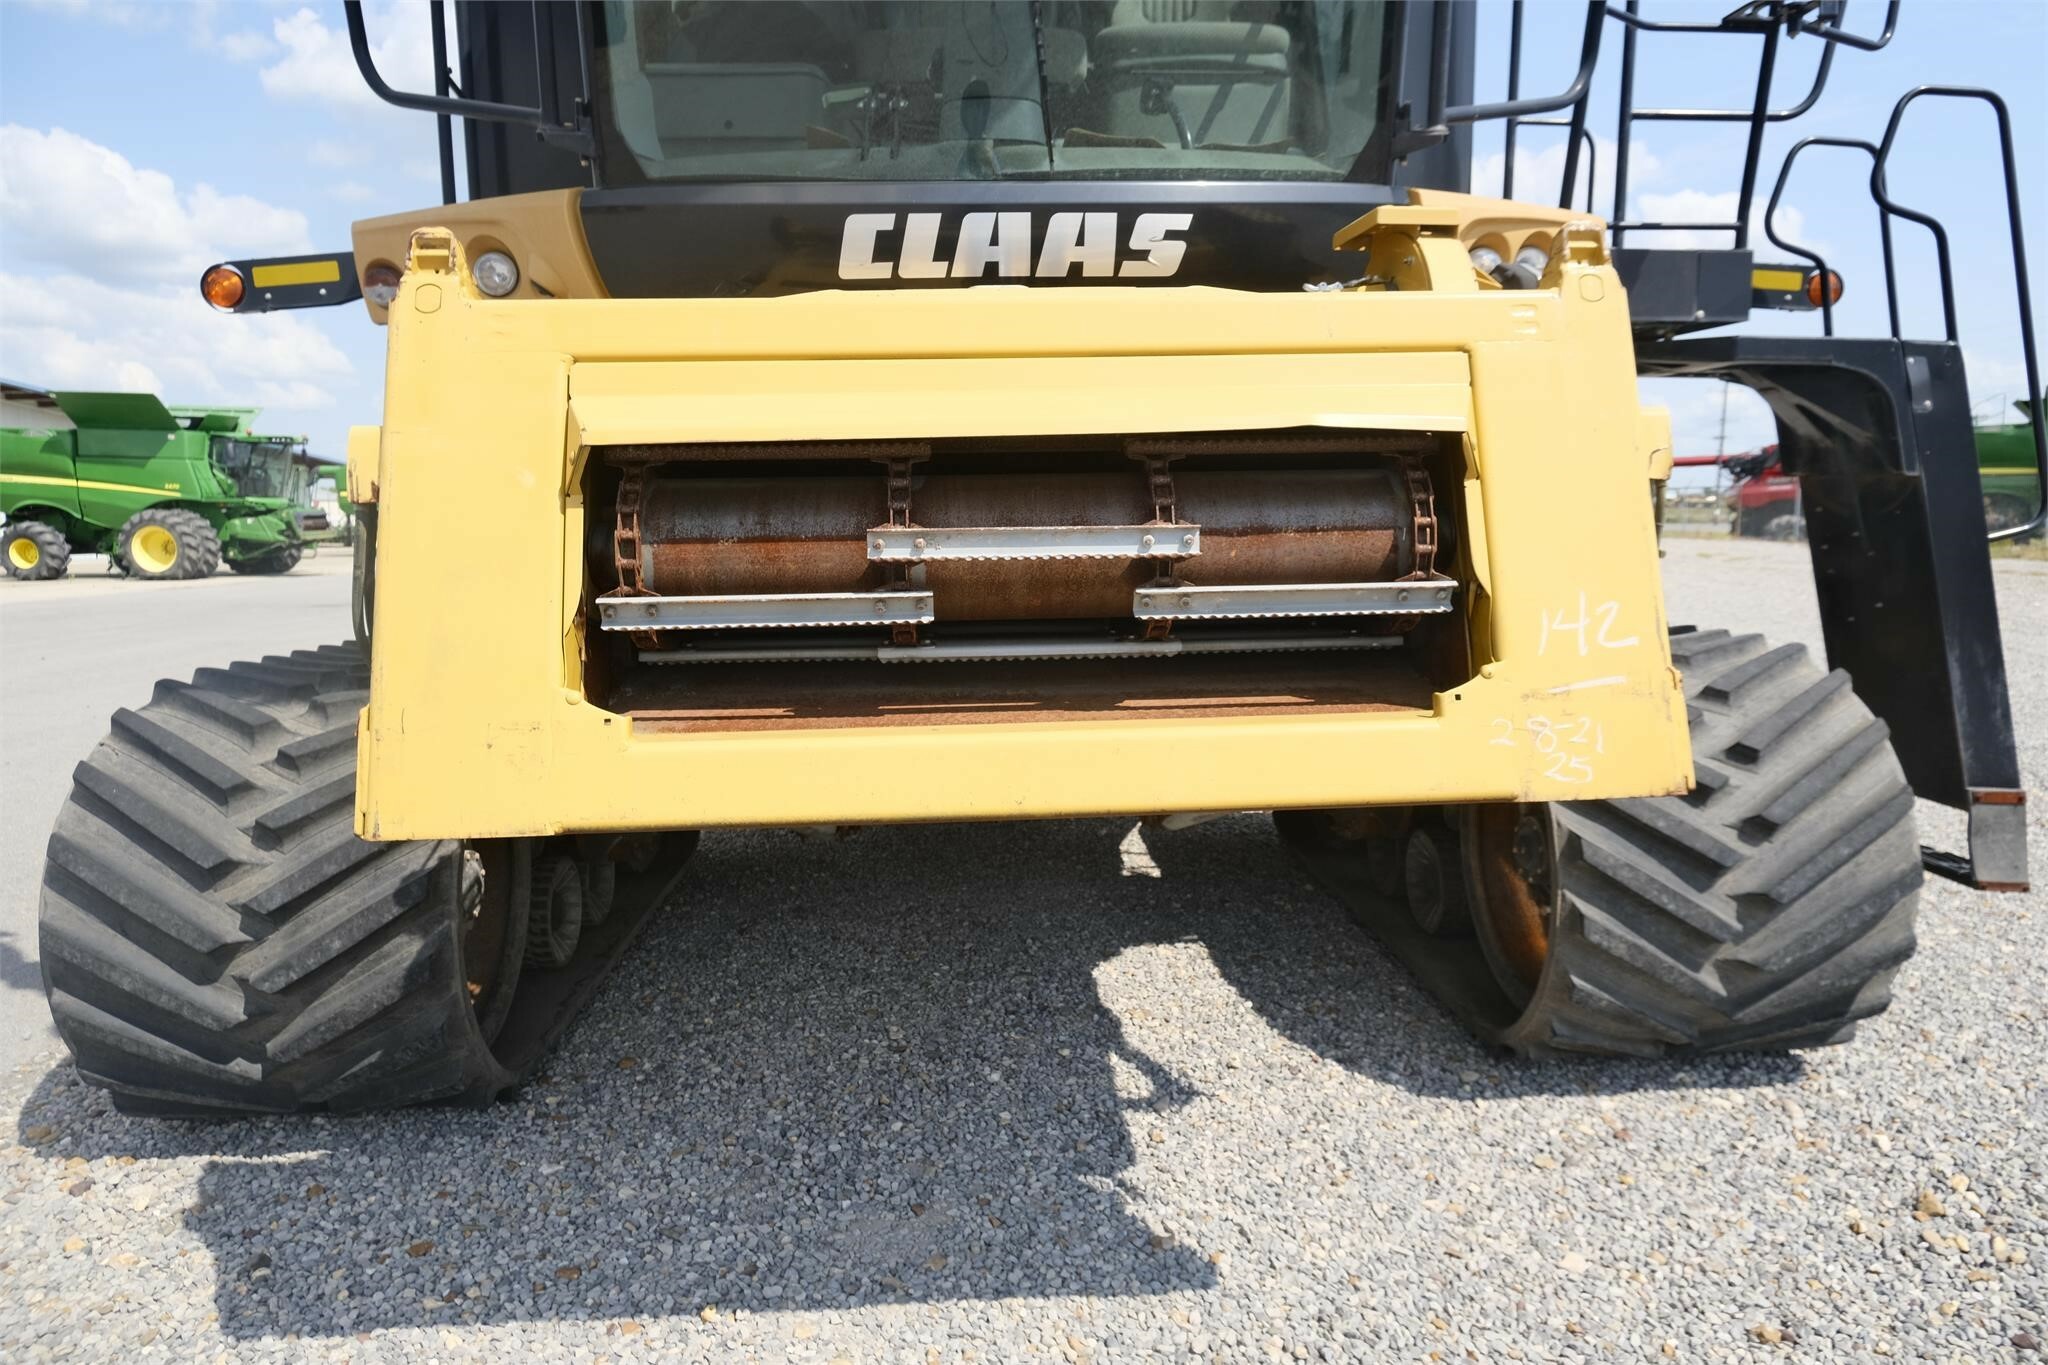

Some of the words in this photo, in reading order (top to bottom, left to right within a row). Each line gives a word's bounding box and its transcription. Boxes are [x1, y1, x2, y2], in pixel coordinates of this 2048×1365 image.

[838, 211, 1194, 279] CLAAS
[1537, 590, 1641, 656] 142
[1543, 752, 1594, 783] 25
